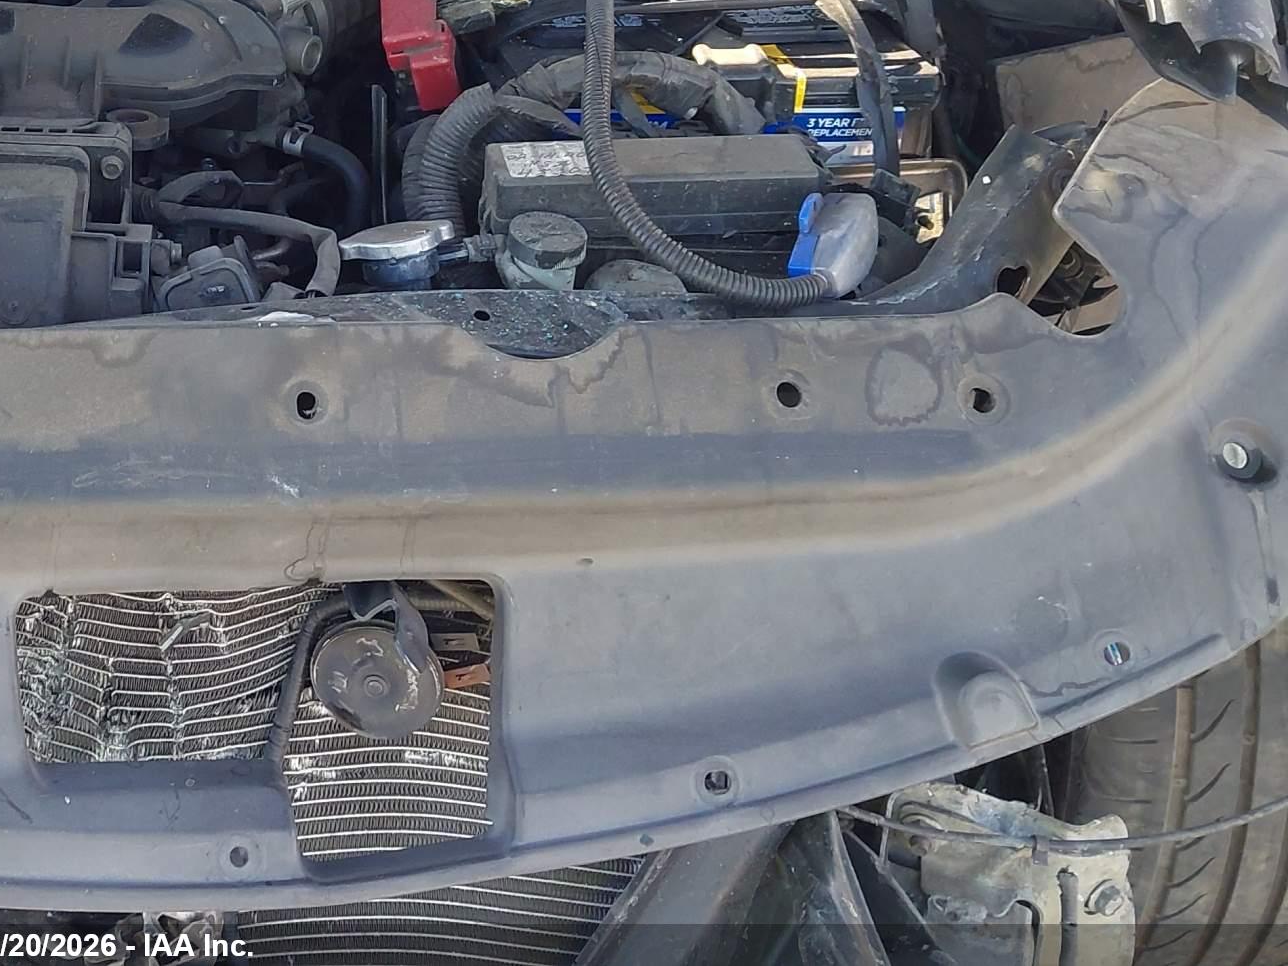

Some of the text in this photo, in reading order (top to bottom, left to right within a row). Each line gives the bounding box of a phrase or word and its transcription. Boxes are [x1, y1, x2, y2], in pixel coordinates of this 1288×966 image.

[806, 118, 817, 128] 3
[818, 118, 850, 128] YEAR
[808, 128, 873, 137] REPLACEMEN
